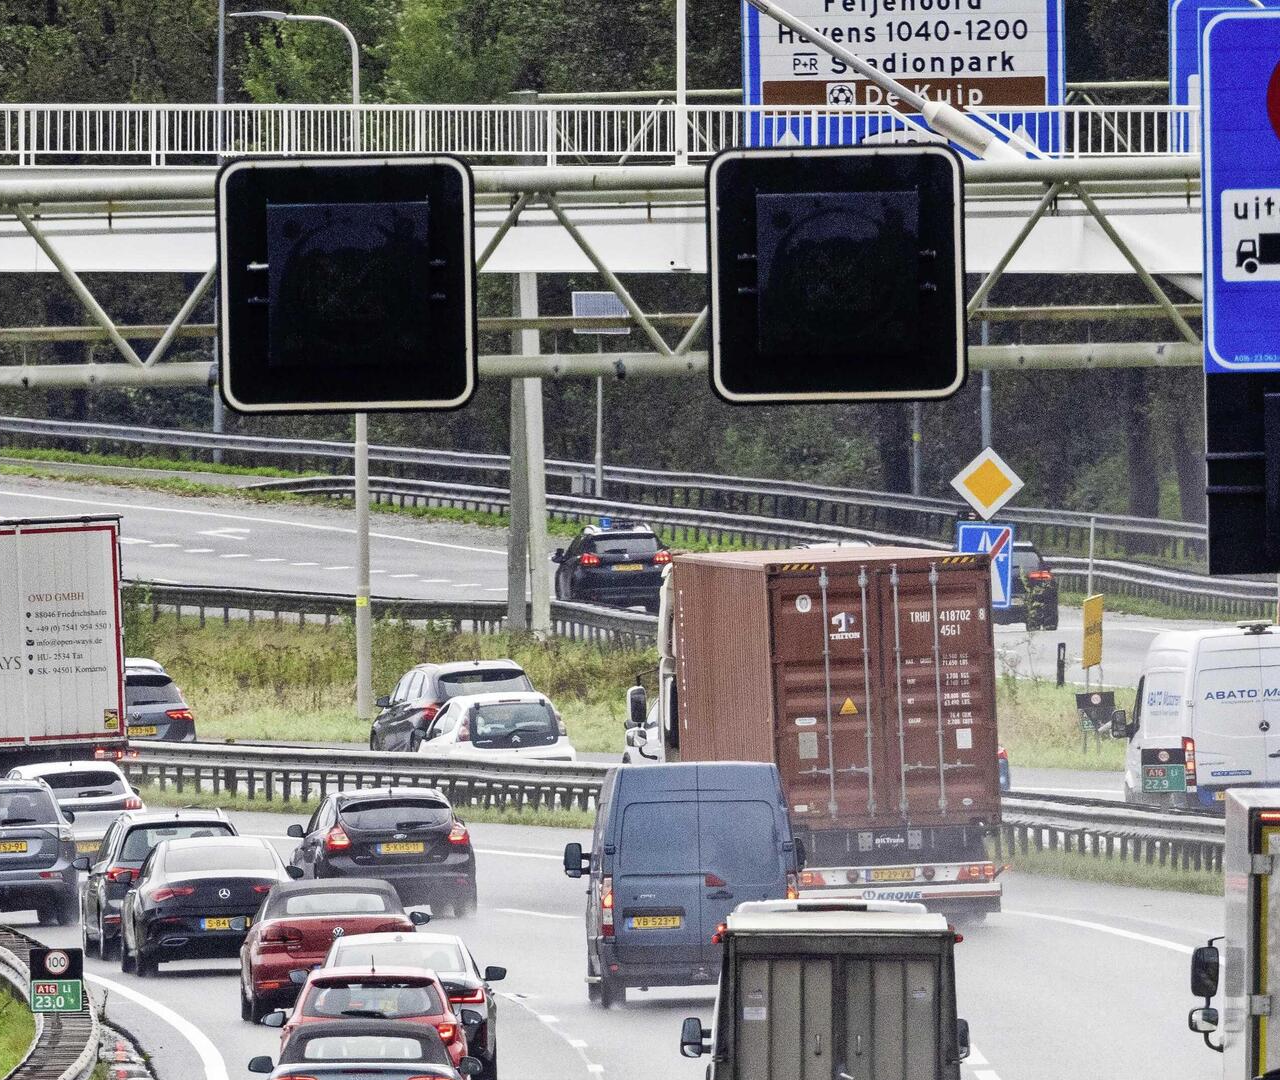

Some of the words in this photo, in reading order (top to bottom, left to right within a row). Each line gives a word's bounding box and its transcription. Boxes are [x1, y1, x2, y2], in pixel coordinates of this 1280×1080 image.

[886, 19, 1028, 42] 1040-1200
[793, 56, 818, 72] P+R
[865, 85, 899, 106] De
[27, 593, 53, 603] OWD
[54, 591, 85, 602] GMBH
[910, 611, 931, 623] TRHU
[939, 609, 971, 622] 418702
[829, 631, 861, 640] TRITON
[1204, 688, 1258, 701] ABATO
[876, 890, 923, 900] KRONE
[48, 956, 66, 968] 100
[37, 984, 56, 994] A16
[62, 984, 71, 993] Li
